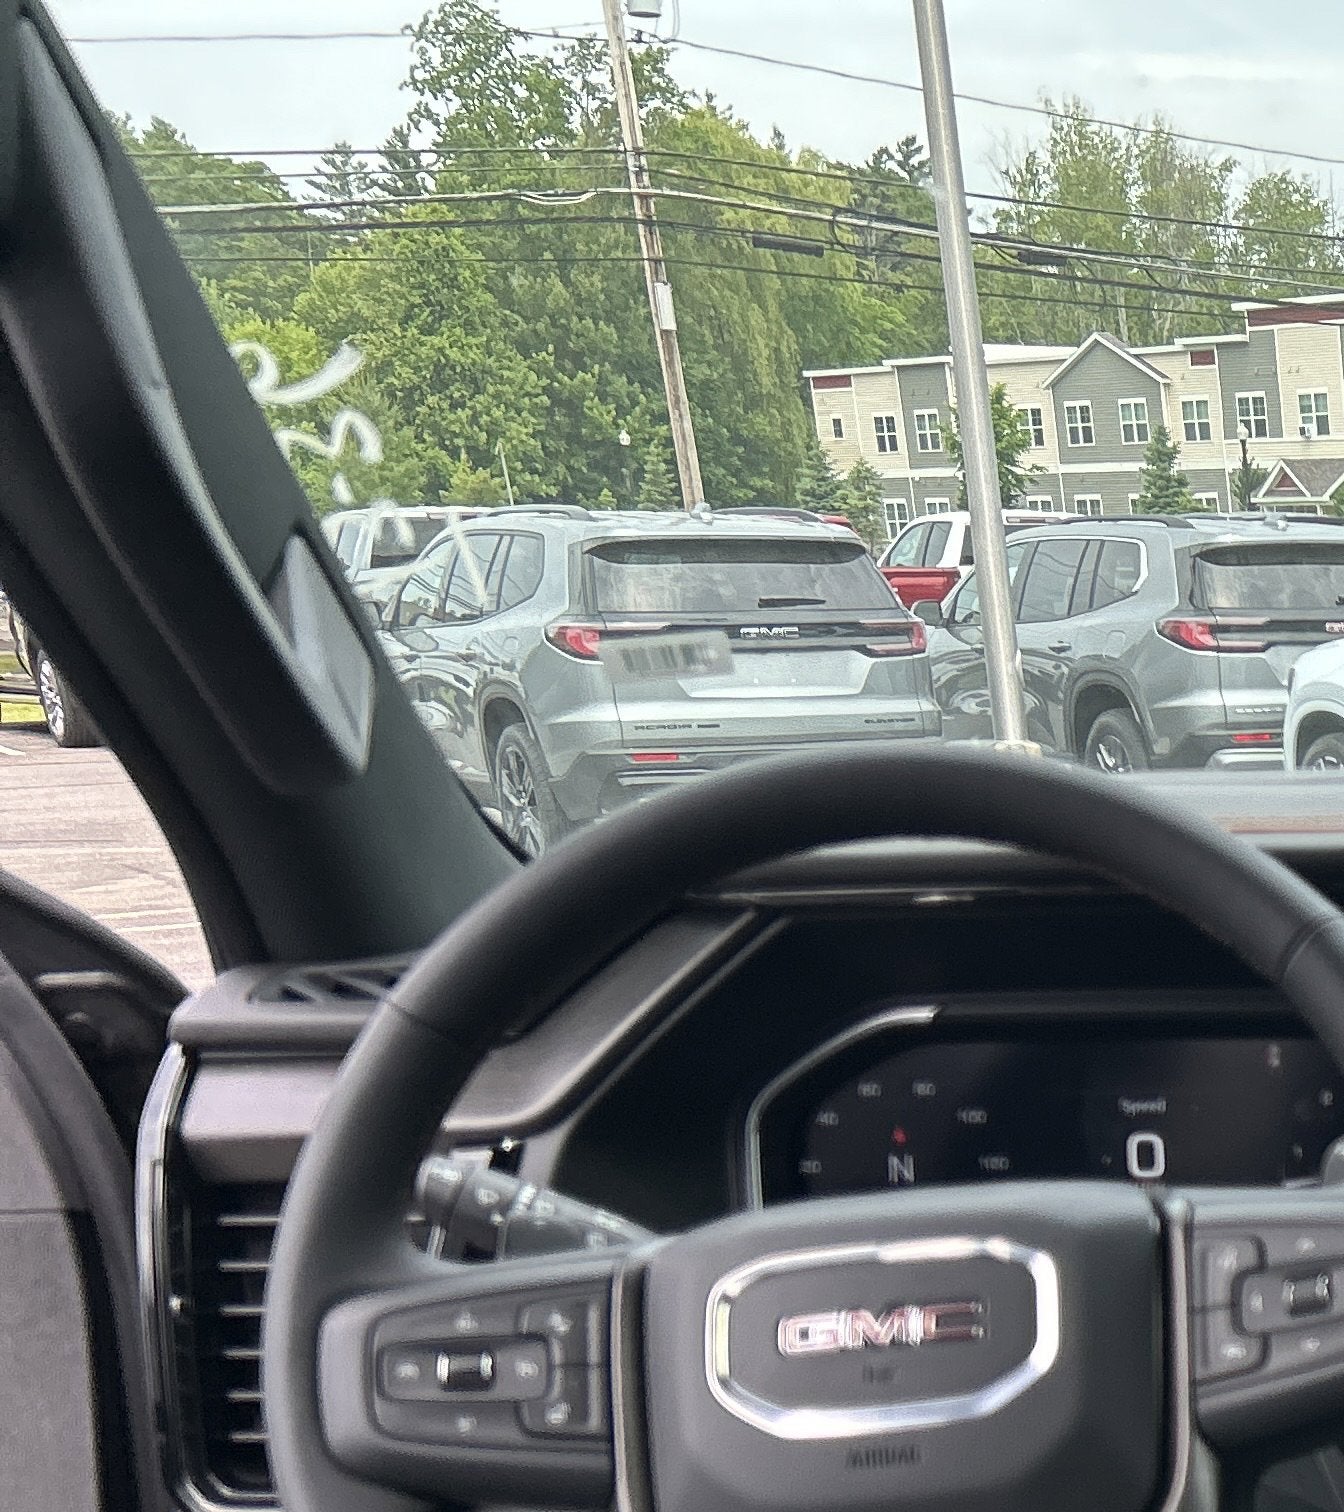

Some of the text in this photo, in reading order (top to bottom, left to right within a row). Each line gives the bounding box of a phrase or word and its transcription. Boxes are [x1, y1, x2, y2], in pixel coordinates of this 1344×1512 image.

[740, 626, 799, 639] GMC
[887, 1152, 916, 1184] N
[1126, 1131, 1166, 1178] 0
[778, 1299, 989, 1358] GMC
